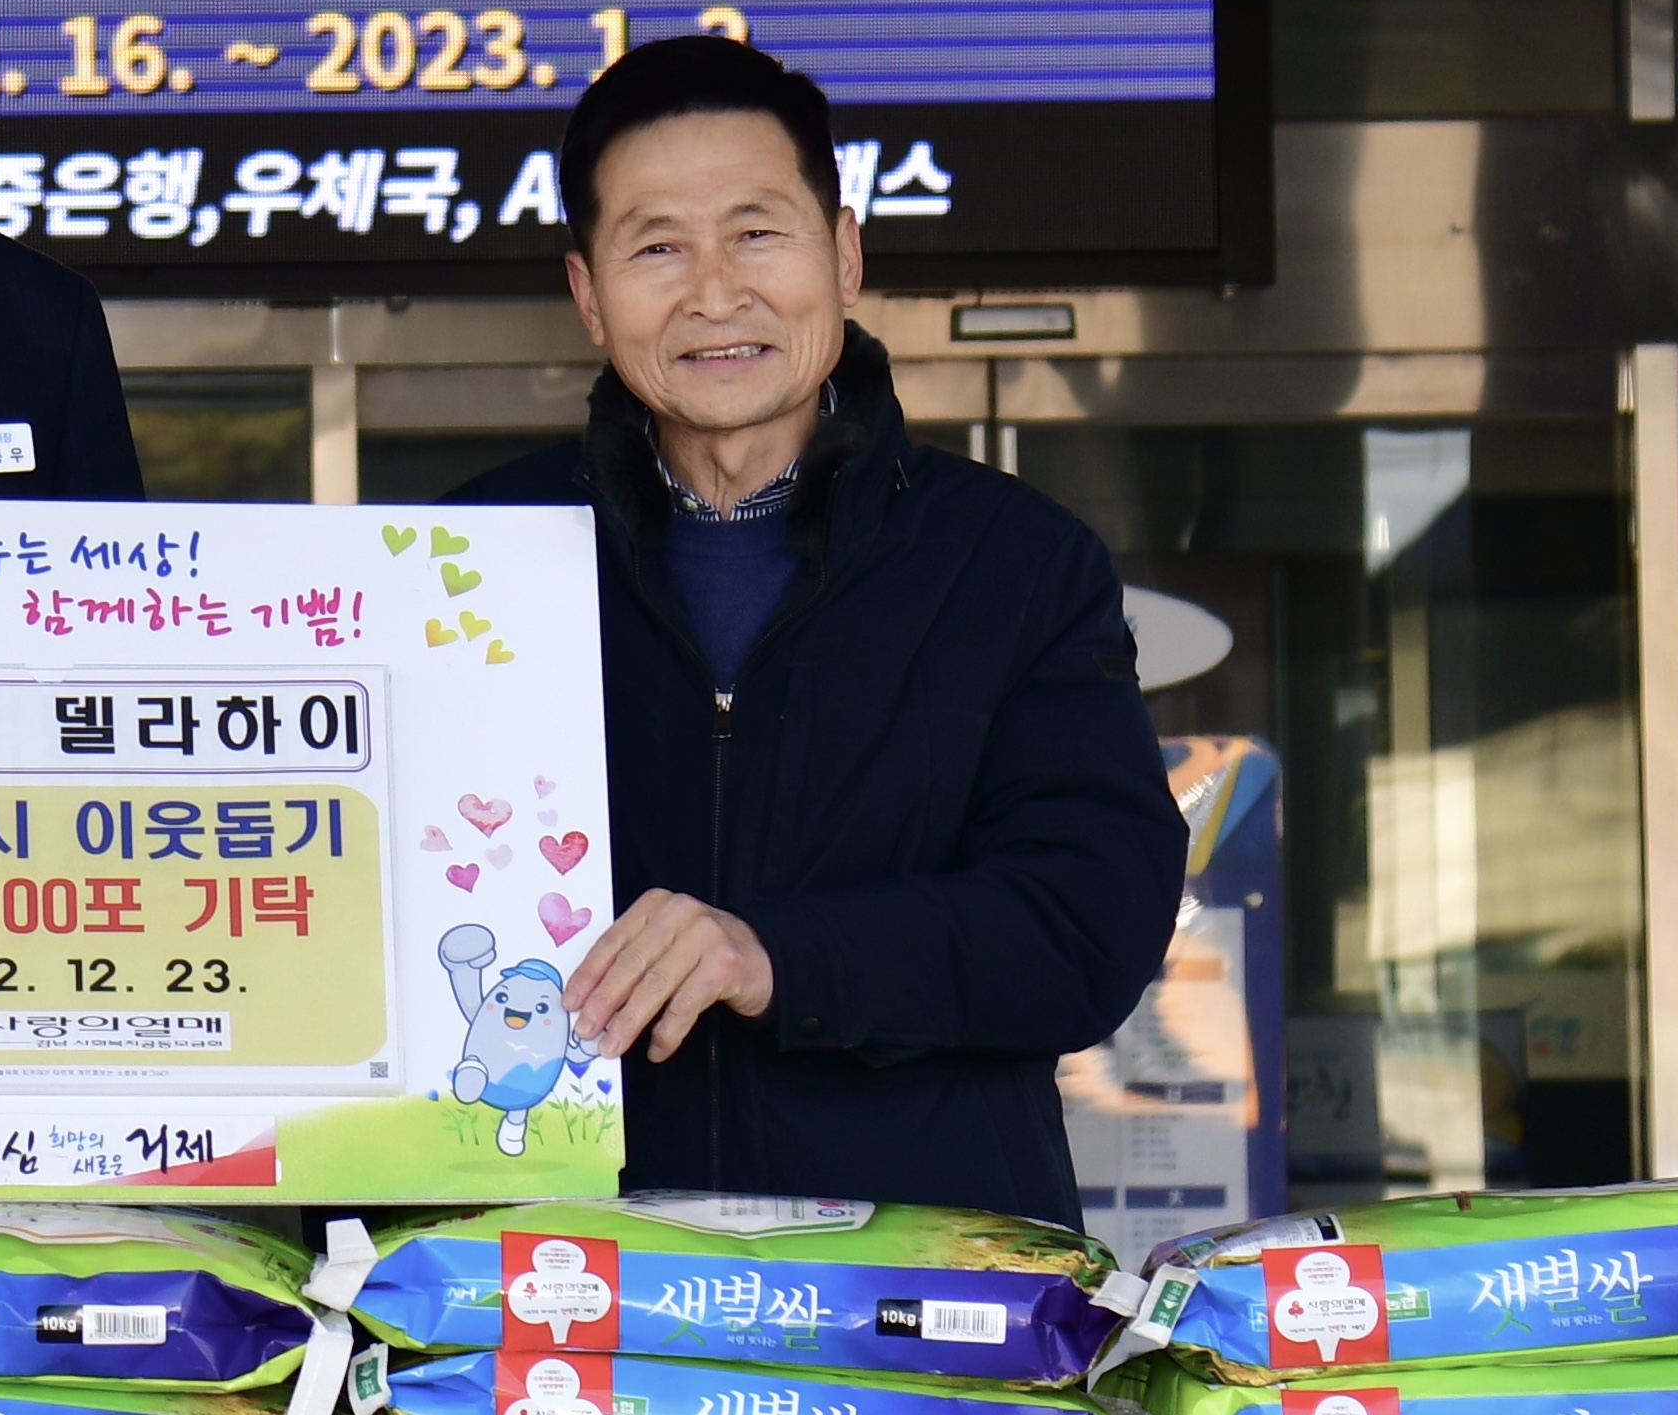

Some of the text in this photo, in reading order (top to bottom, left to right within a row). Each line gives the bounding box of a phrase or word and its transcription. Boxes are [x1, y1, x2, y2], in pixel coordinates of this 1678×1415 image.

[60, 15, 194, 98] 16.
[306, 9, 555, 94] 2023.
[70, 531, 199, 577] 세상!
[22, 586, 362, 646] 함께하는 기쁨!
[55, 695, 359, 756] 델라하이
[76, 798, 343, 860] 이웃돕기
[184, 875, 314, 937] 기탁
[67, 958, 134, 993] 12.
[166, 958, 247, 993] 23.
[49, 1125, 104, 1150] 희망의
[126, 1124, 214, 1175] 거제
[73, 1154, 124, 1176] 새로운
[41, 1315, 77, 1334] 10kg
[881, 1309, 916, 1327] 10kg
